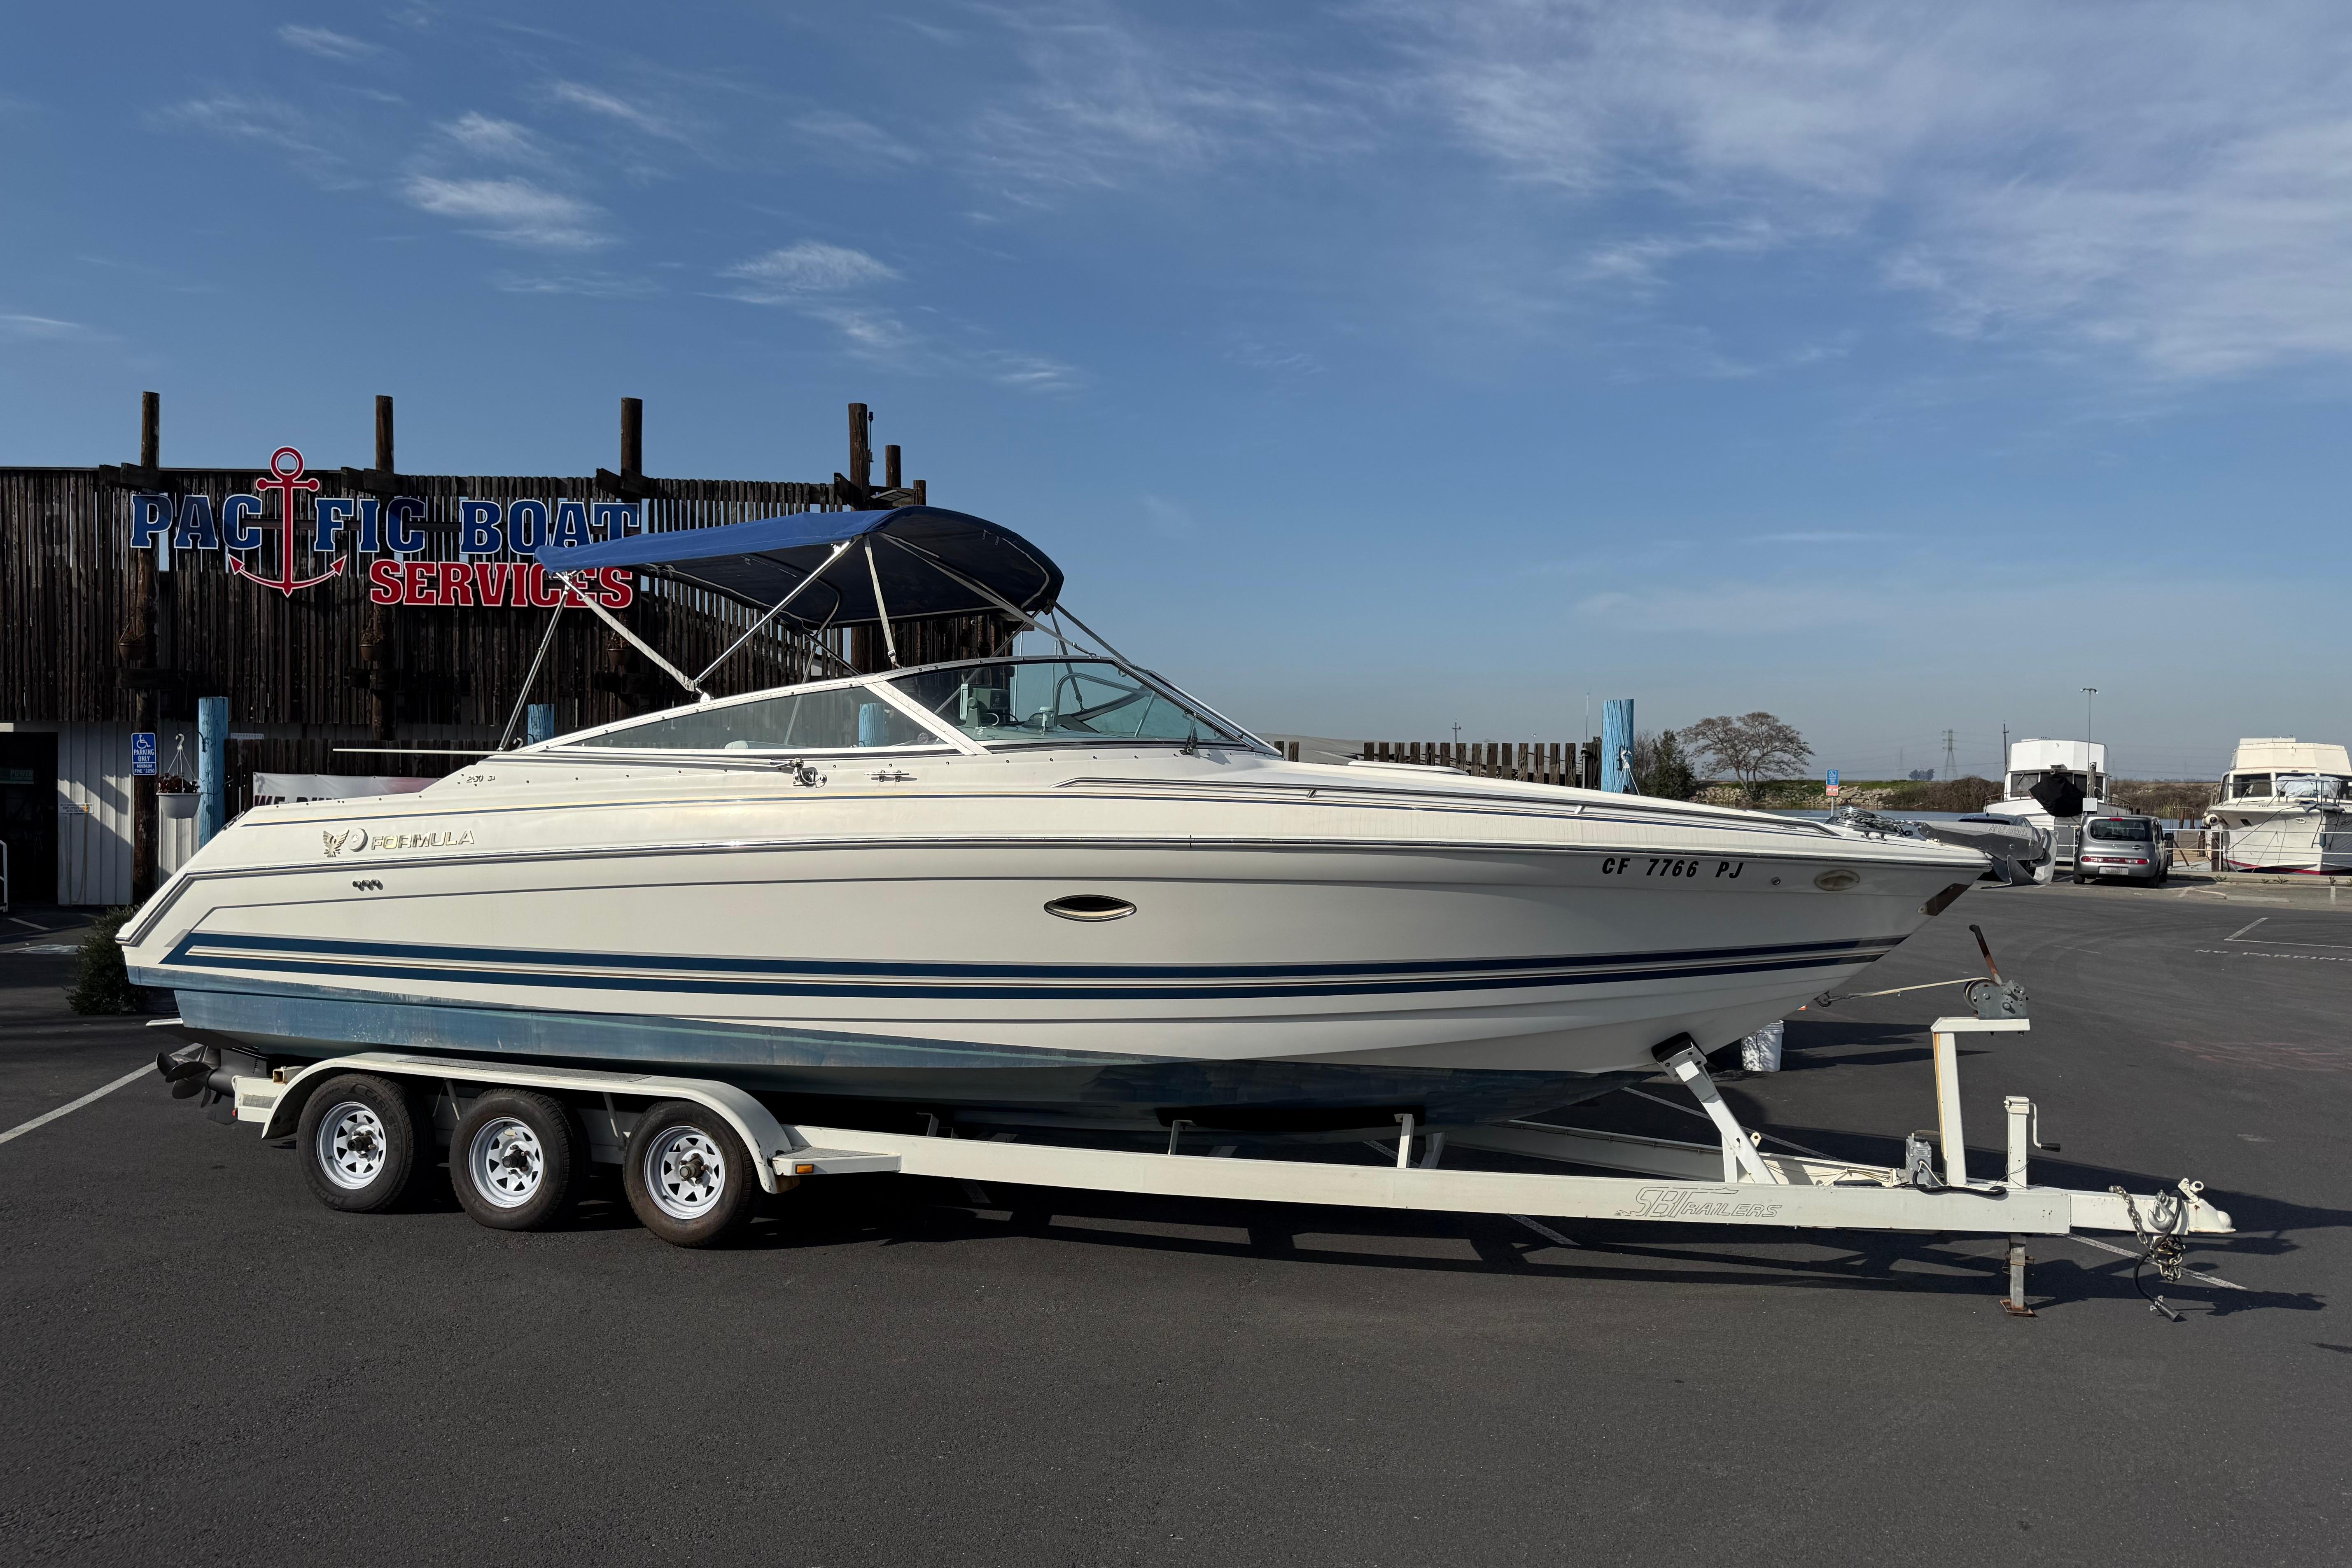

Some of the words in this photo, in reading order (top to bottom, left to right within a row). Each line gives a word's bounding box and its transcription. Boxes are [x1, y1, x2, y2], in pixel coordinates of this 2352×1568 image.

[459, 499, 639, 555] BOAT
[370, 558, 633, 609] SERVICES
[371, 830, 474, 850] FORMULA
[1602, 857, 1631, 874] CF
[1646, 859, 1699, 877] 7766
[1715, 861, 1744, 879] PJ
